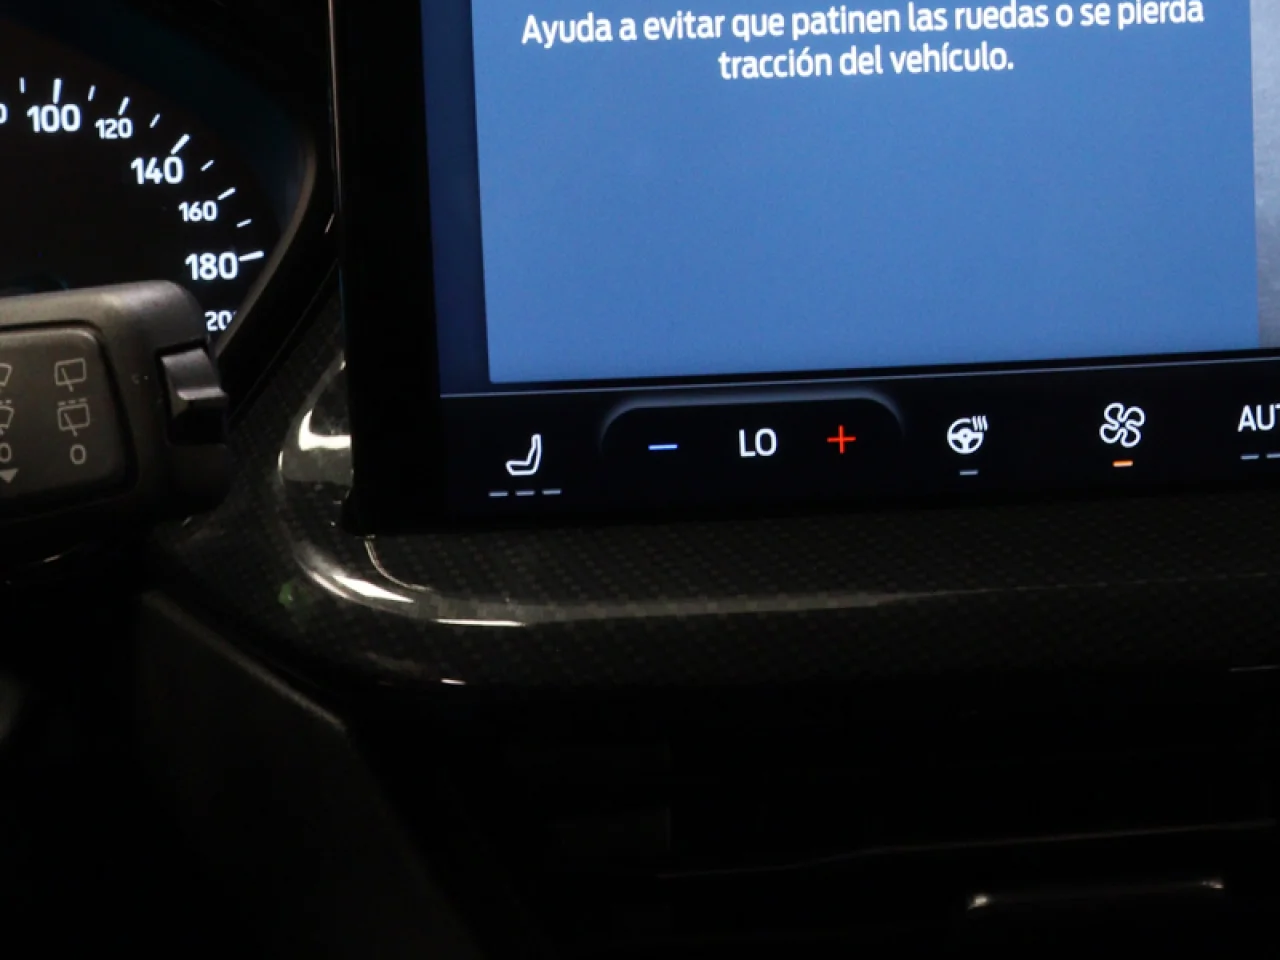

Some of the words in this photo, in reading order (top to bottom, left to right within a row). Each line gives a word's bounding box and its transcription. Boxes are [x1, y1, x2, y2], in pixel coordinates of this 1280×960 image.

[521, 11, 614, 49] Ayuda
[618, 17, 638, 41] a
[642, 10, 726, 41] evitar
[731, 12, 785, 43] que
[791, 4, 902, 41] patinen
[907, 1, 949, 33] las
[1055, 3, 1074, 28] o
[1079, 2, 1111, 27] se
[717, 46, 833, 80] tracción
[839, 44, 884, 76] del
[889, 40, 1014, 75] vehículo.
[26, 103, 81, 133] 100
[95, 117, 133, 140] 120
[130, 156, 184, 185] 140
[178, 200, 218, 222] 160
[184, 251, 238, 281] 180
[738, 428, 777, 457] LO
